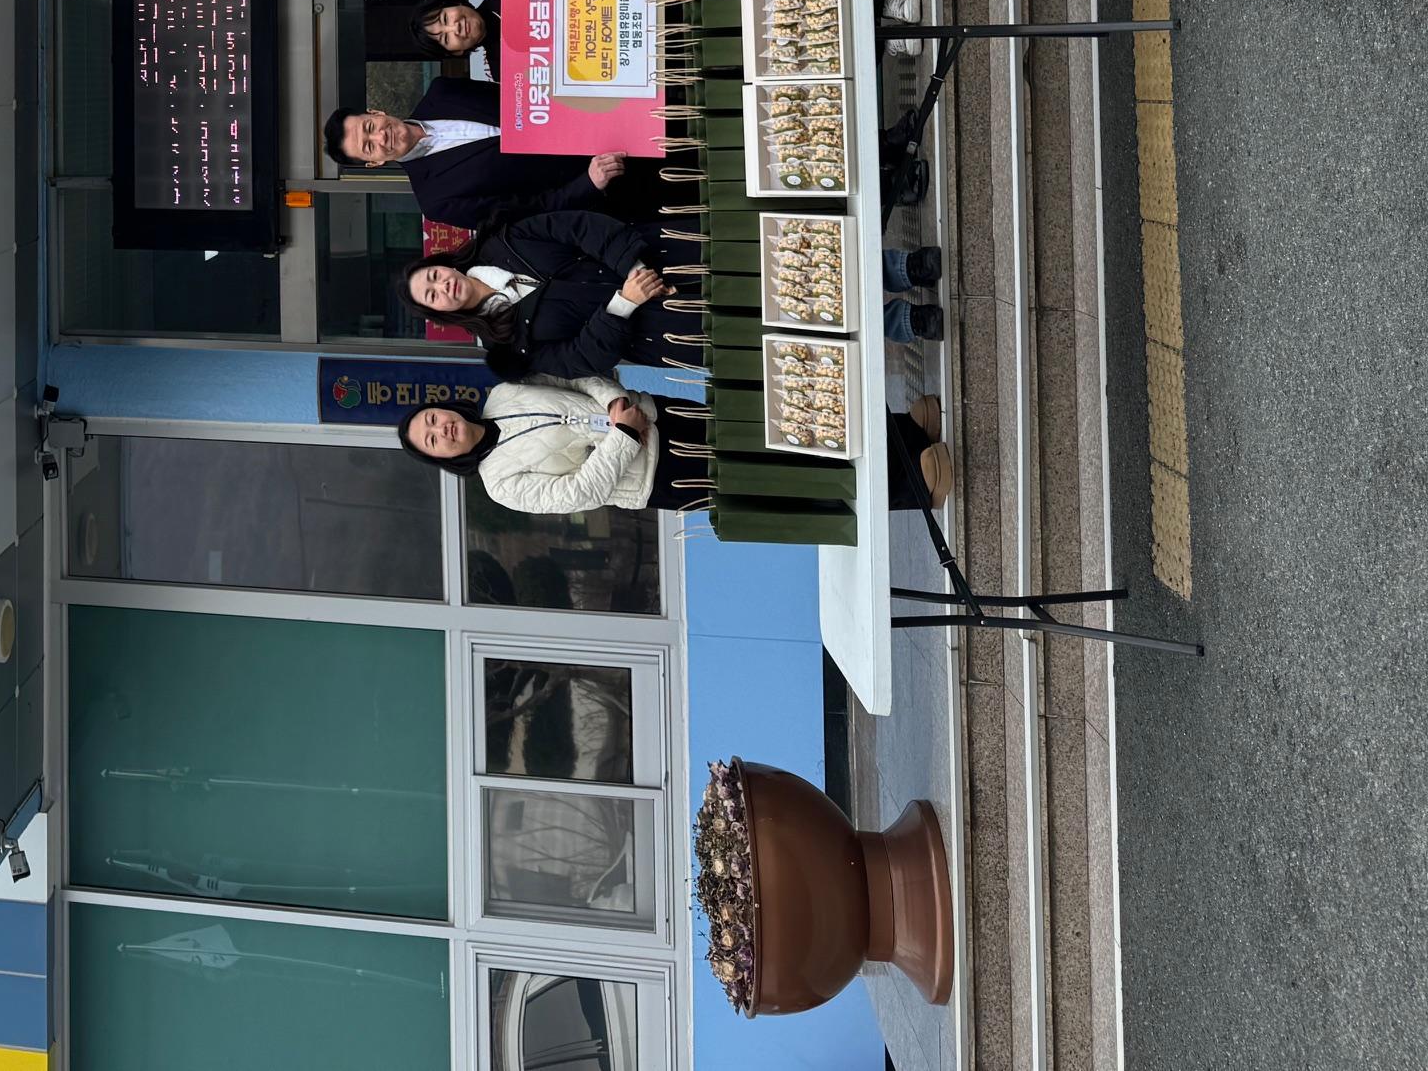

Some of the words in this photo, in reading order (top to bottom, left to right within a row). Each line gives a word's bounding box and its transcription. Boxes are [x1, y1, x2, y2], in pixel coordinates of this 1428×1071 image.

[585, 20, 597, 59] 110만원
[601, 6, 613, 43] 50세트
[631, 11, 643, 49] 협동조합
[529, 47, 550, 125] 이웃돕기
[366, 381, 490, 406] 동면행정
